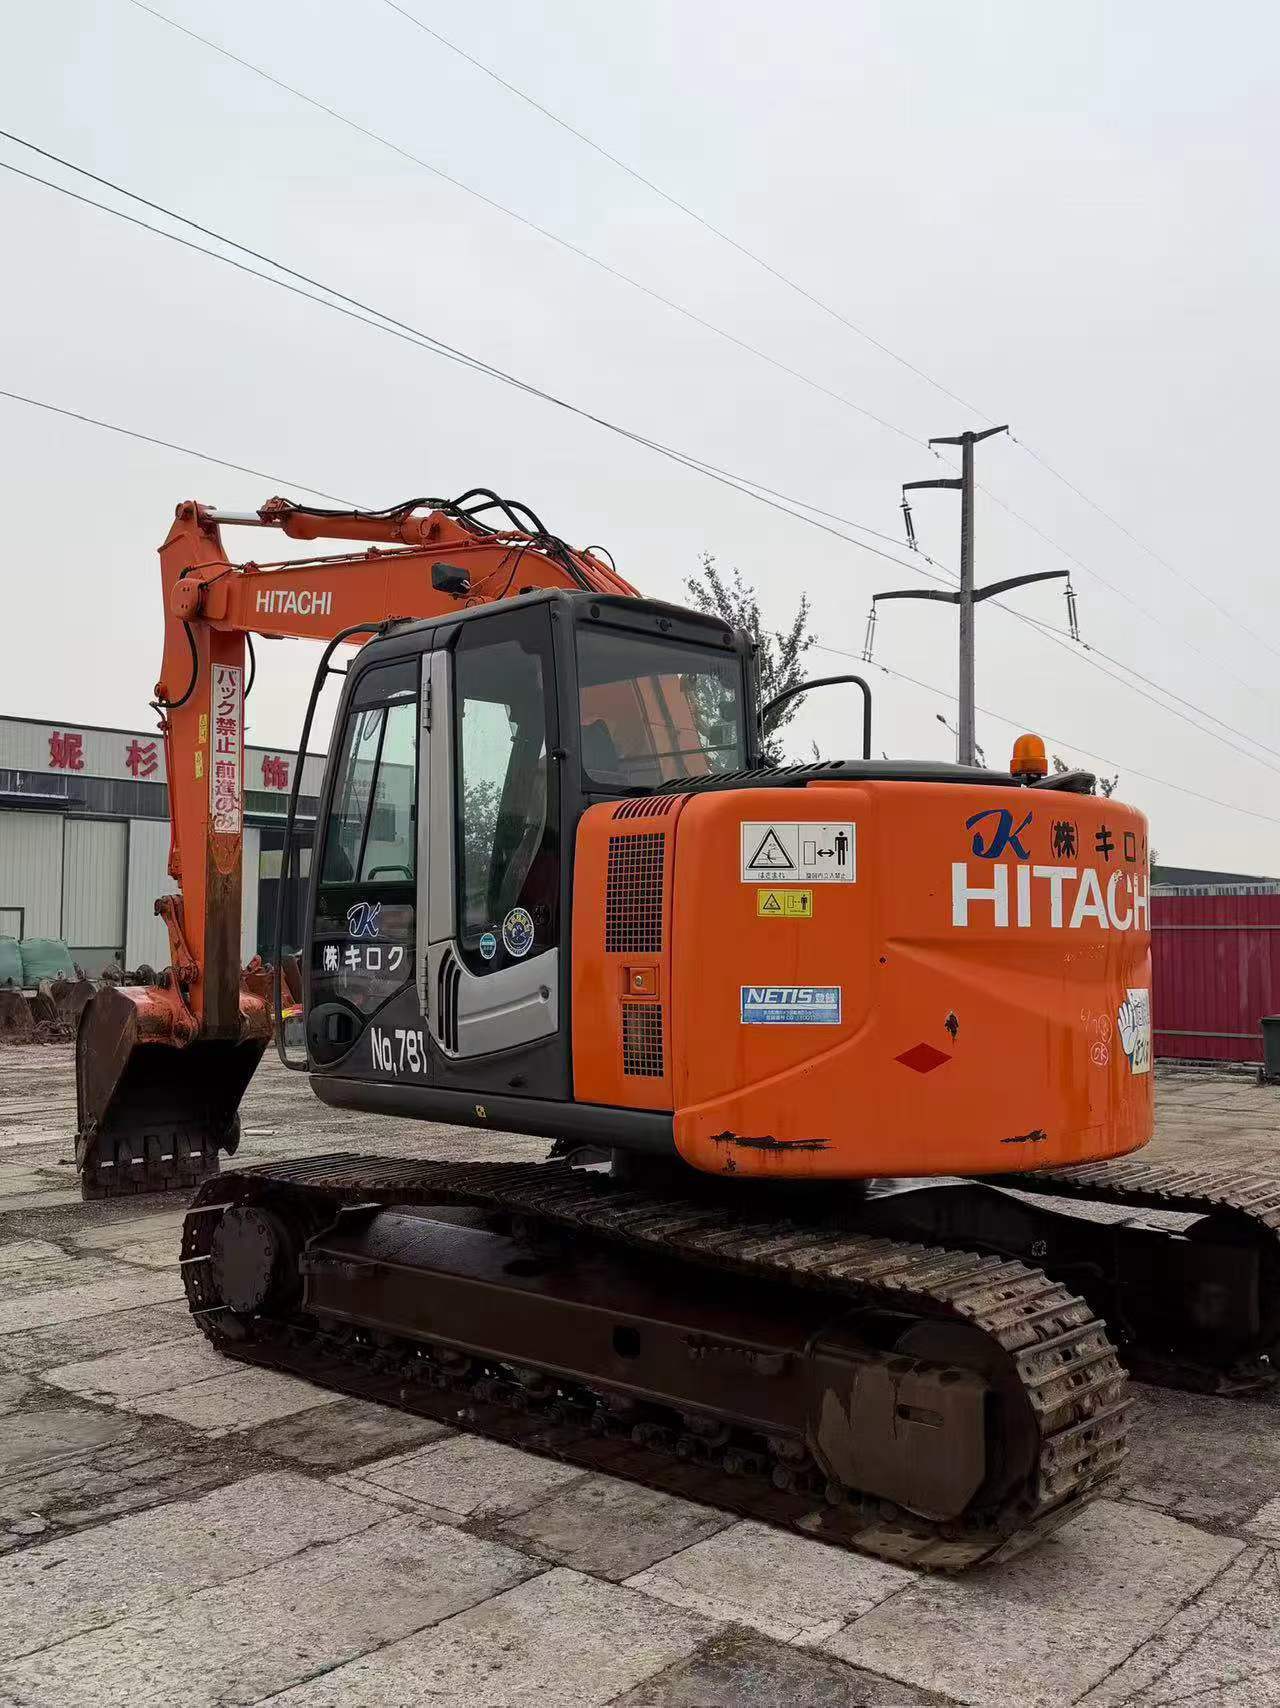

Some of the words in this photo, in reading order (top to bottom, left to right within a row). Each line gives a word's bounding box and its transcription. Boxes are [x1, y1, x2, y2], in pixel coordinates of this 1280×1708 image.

[256, 590, 333, 615] HITACHI
[215, 669, 238, 755] バック禁止
[746, 988, 814, 1004] NETIS
